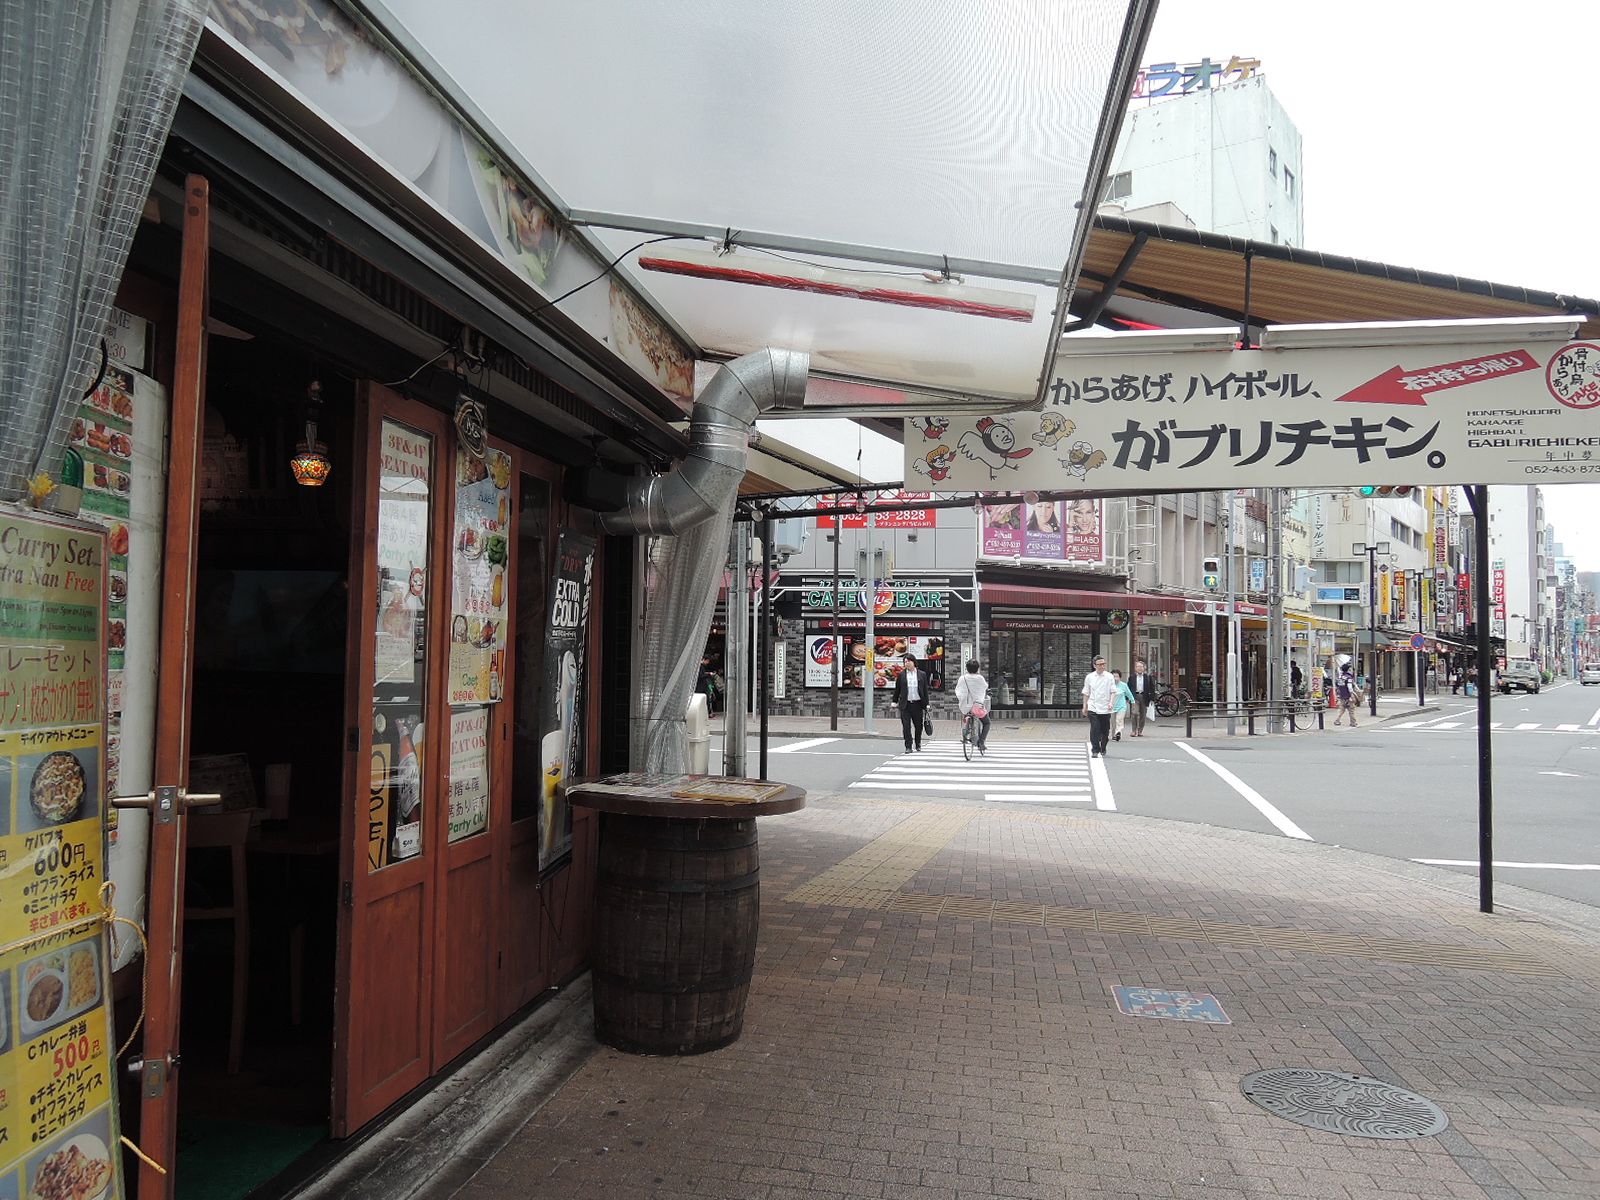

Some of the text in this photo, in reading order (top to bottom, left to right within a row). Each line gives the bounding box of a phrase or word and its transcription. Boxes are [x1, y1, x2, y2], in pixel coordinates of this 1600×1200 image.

[1397, 355, 1525, 391] お持ち帰り
[1552, 354, 1573, 397] からあげ
[1568, 381, 1599, 404] TAKE
[1111, 416, 1446, 471] がブリチキン。
[1467, 437, 1600, 448] GABURICHICKE
[1, 526, 94, 567] Curry Set
[28, 565, 60, 588] Nan
[64, 570, 95, 592] Free
[555, 578, 580, 602] EXTRA
[807, 590, 857, 607] CAFE
[896, 590, 943, 608] BAR
[551, 598, 580, 628] COLD
[21, 728, 95, 746] テイクアウトメニュー
[448, 817, 472, 835] Party
[30, 887, 78, 914] ミニサラダ
[36, 1064, 93, 1104] チキンカレー
[39, 1099, 86, 1140] ミニサラダ
